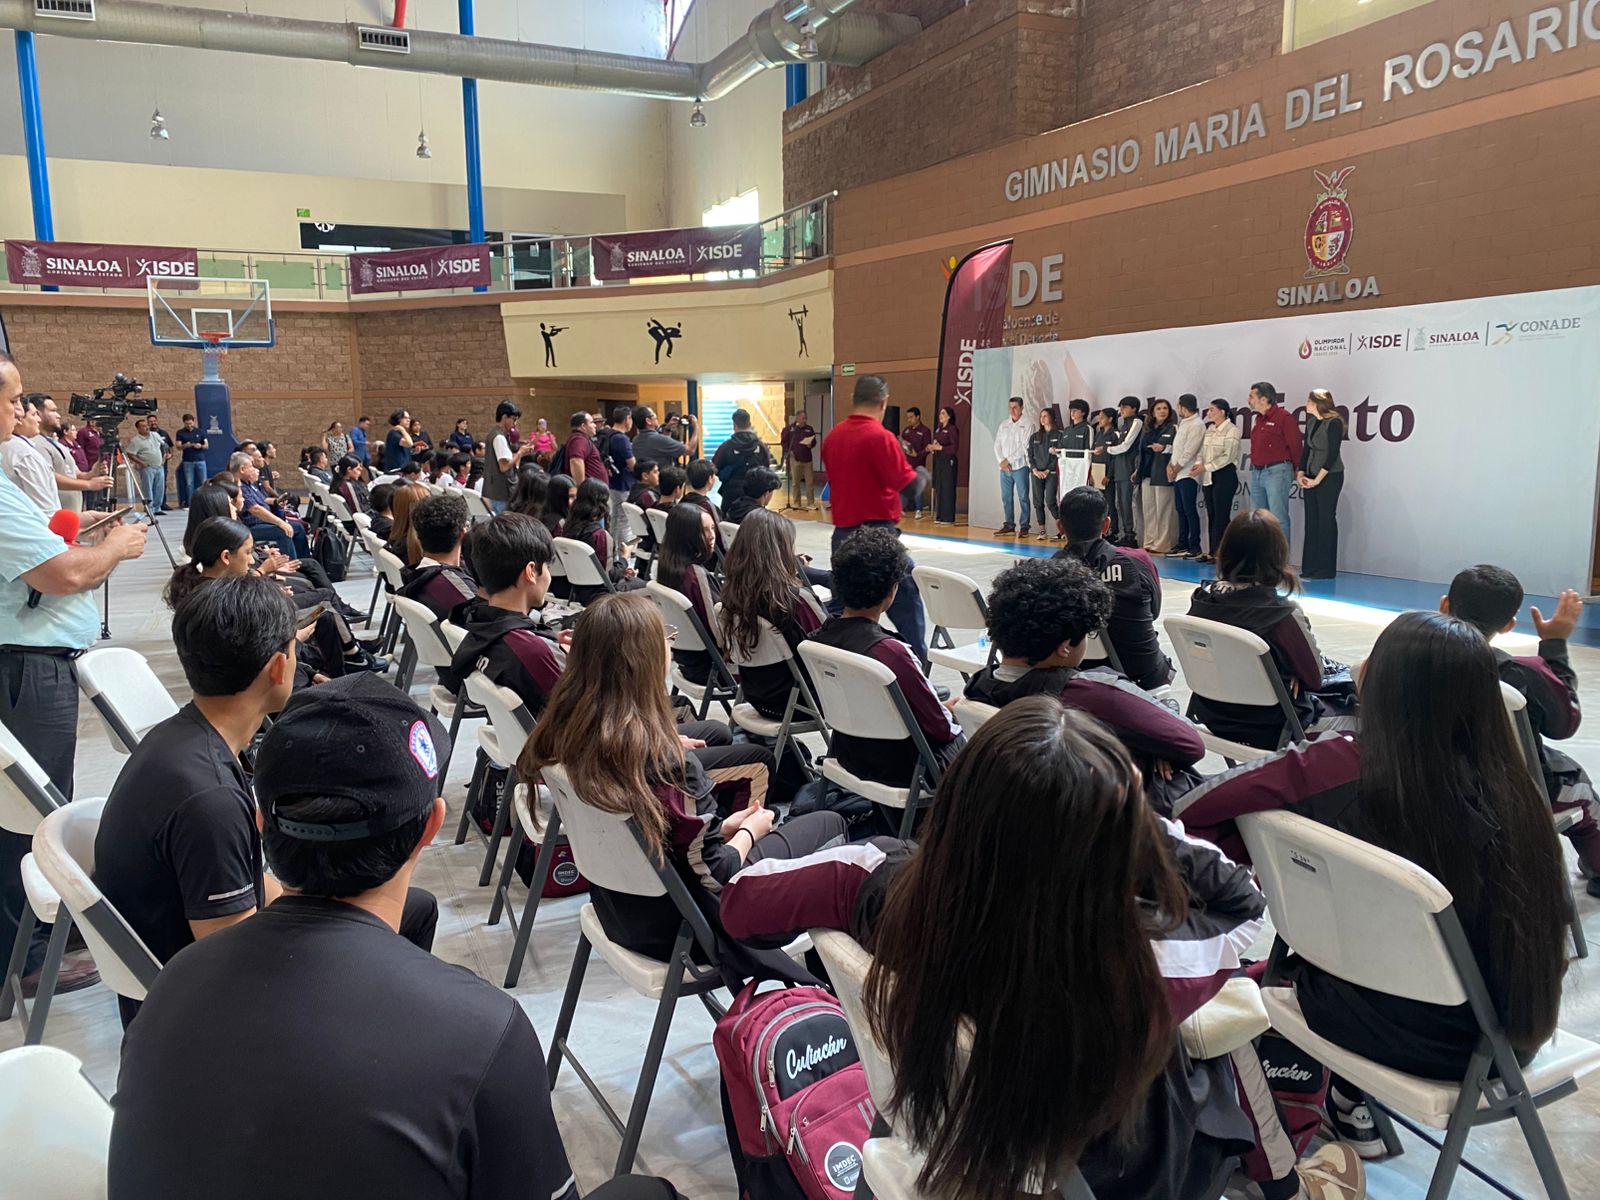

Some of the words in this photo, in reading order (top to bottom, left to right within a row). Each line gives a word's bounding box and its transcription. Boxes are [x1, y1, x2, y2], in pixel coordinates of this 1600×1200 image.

[1004, 138, 1141, 203] GIMNASIO
[1153, 102, 1267, 167] MARIA
[1285, 73, 1364, 131] DEL
[627, 247, 685, 263] SINALOA
[46, 257, 122, 273] SINALOA
[376, 263, 428, 279] SINALOA
[1011, 253, 1064, 307] DE
[1276, 275, 1380, 307] SINALOA
[1002, 314, 1042, 330] aloense
[1519, 317, 1581, 333] CONADE
[1369, 333, 1402, 349] ISDE
[1429, 331, 1480, 344] SINALOA
[1314, 344, 1347, 352] NACIONAL
[785, 1034, 848, 1080] Culiacán
[832, 1154, 857, 1173] IMDEC
